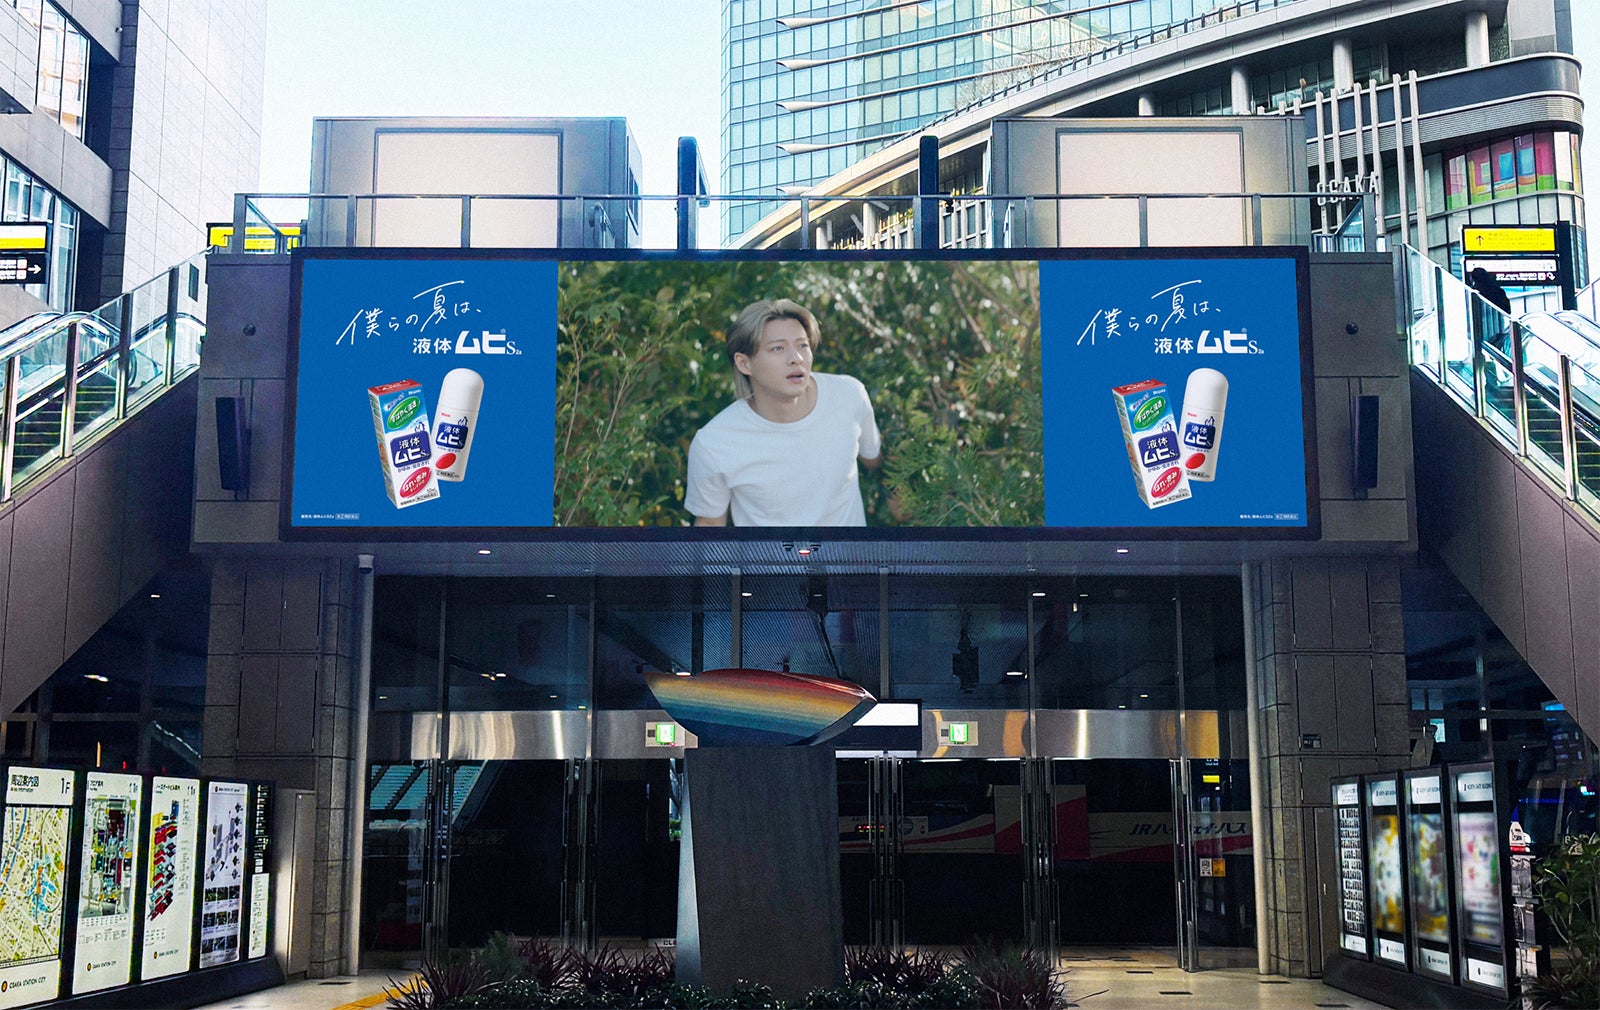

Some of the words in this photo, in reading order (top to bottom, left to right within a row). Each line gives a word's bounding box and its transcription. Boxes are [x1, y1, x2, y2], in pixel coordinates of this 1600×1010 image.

[1317, 171, 1379, 206] OSAKA
[336, 280, 481, 346] 僕らの夏は、
[1076, 279, 1221, 346] 僕らの夏は、
[61, 778, 71, 794] 1F
